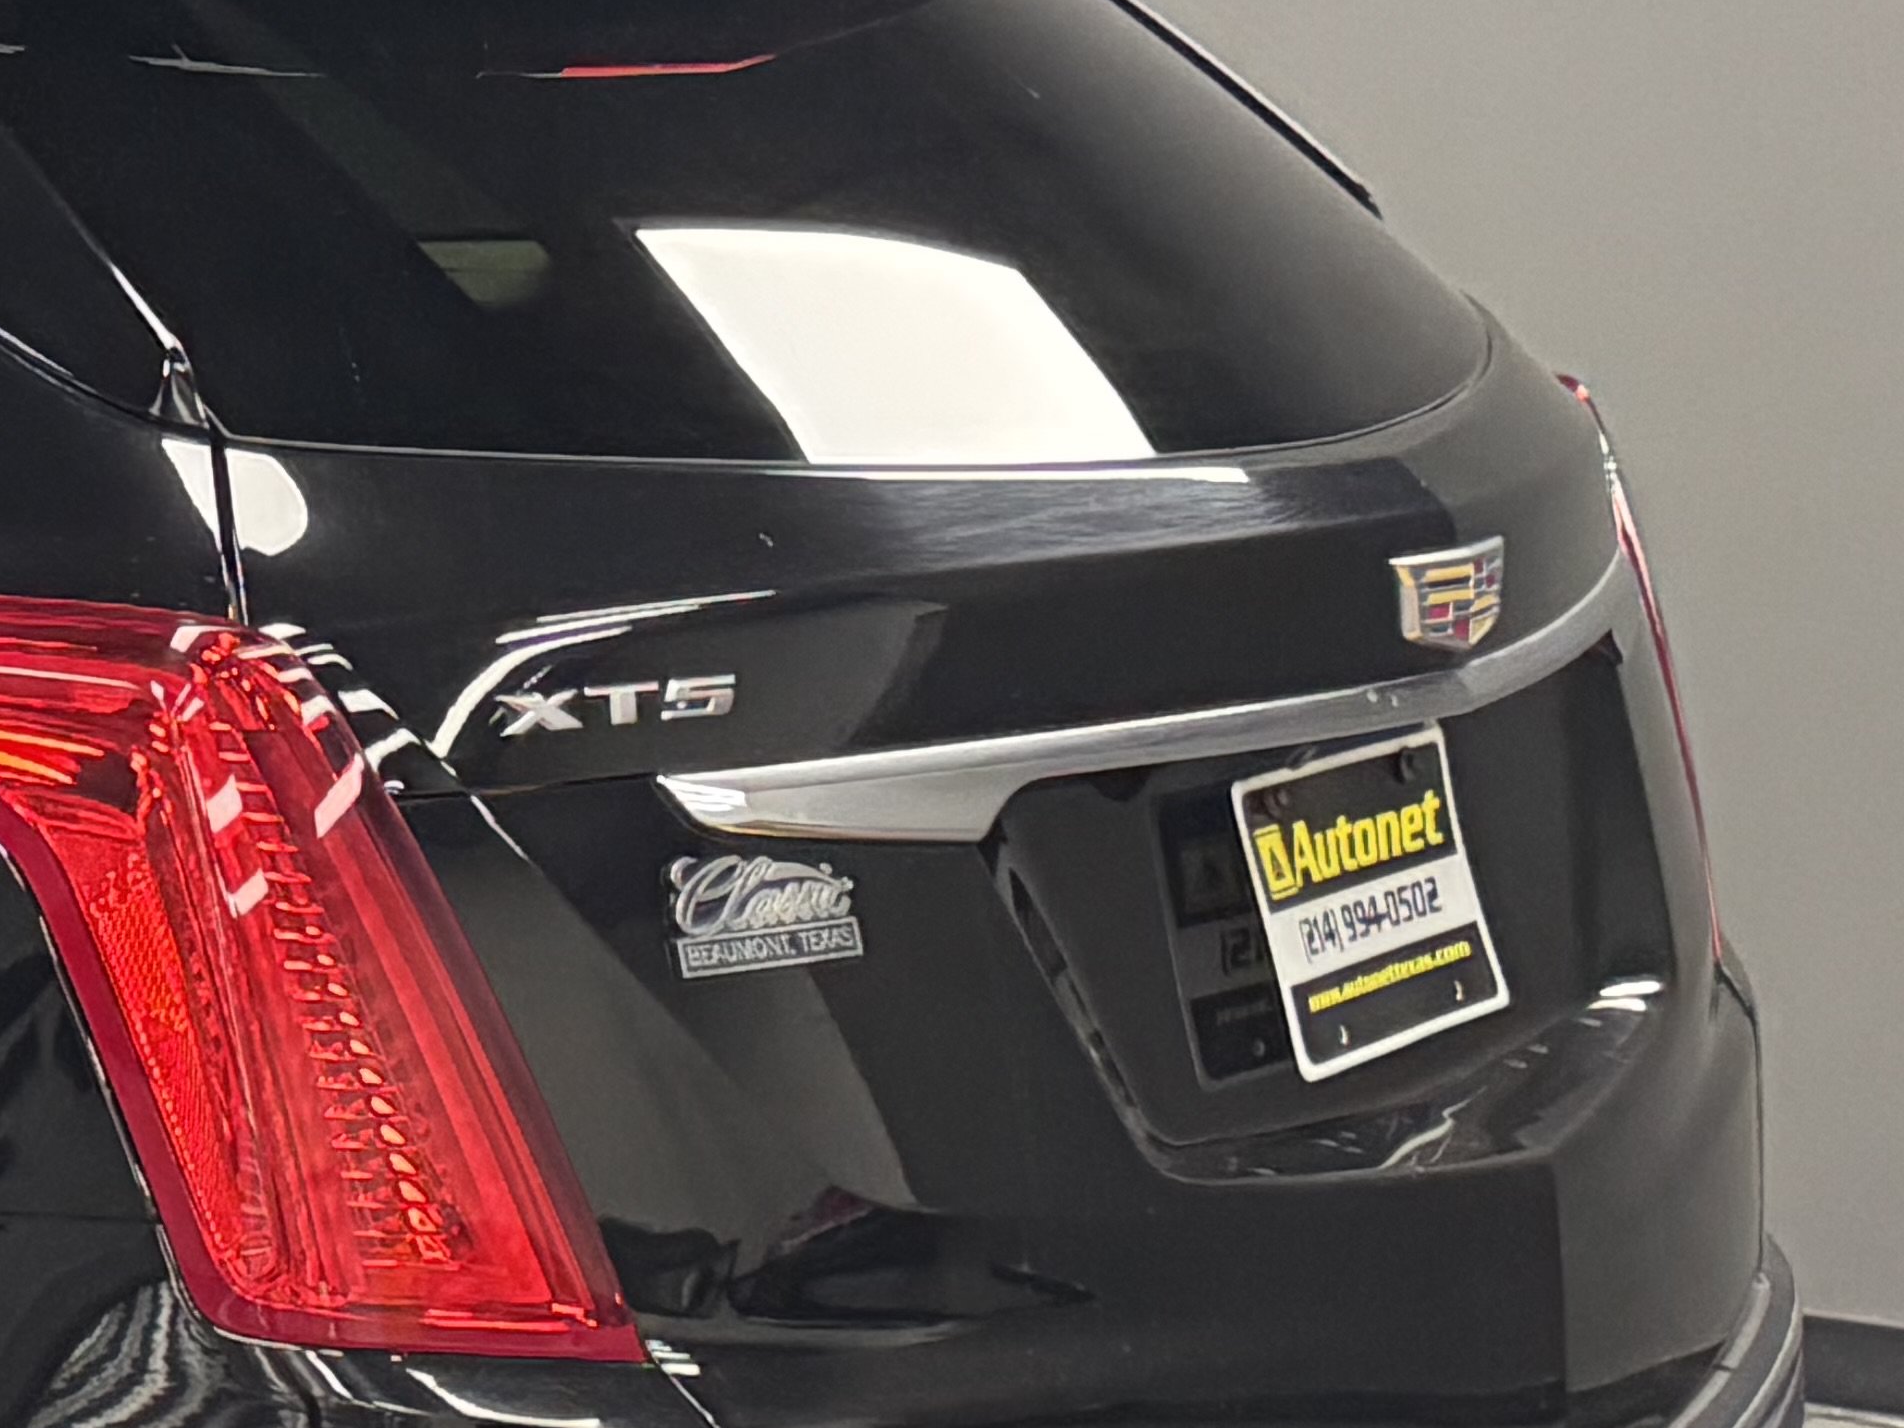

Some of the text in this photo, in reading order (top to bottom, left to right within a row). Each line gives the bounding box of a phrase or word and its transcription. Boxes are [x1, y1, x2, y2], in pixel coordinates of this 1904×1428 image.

[494, 673, 737, 738] XT5
[1293, 789, 1445, 888] Autonet
[670, 854, 855, 938] Classic
[1298, 907, 1344, 965] (214)
[1340, 876, 1442, 943] 994-0502
[798, 926, 854, 953] TEXAS
